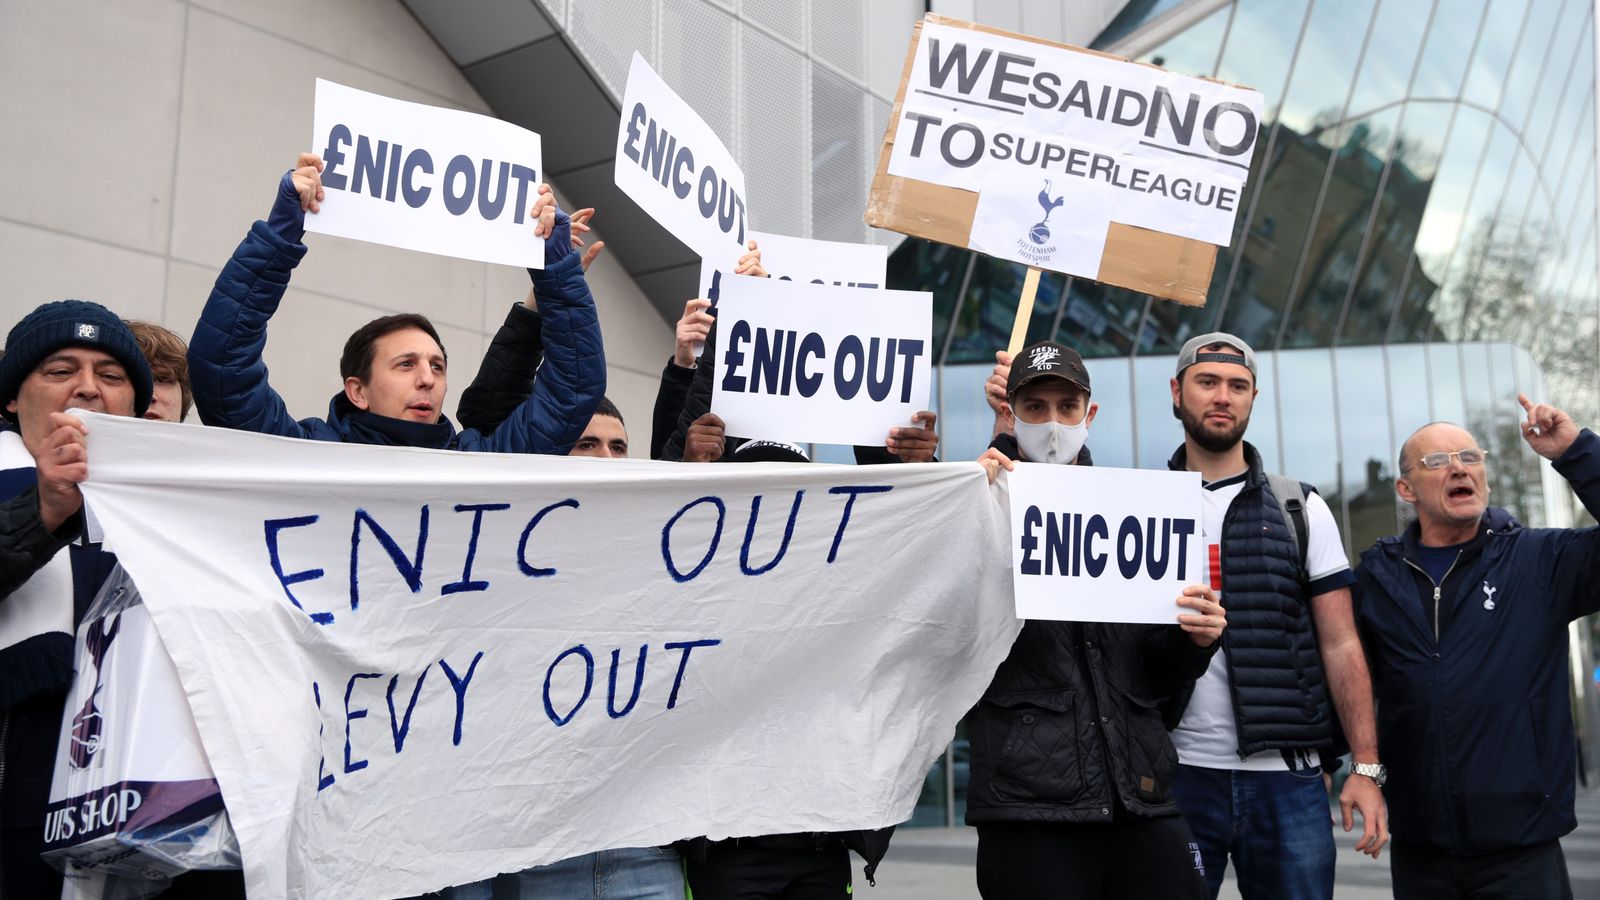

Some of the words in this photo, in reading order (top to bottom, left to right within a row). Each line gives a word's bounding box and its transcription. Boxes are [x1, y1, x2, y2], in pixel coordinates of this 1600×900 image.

[928, 37, 1036, 107] WE
[1027, 72, 1148, 128] SAID
[1144, 85, 1257, 156] NO
[321, 123, 434, 209] £NIC
[442, 154, 536, 225] OUT
[623, 102, 694, 200] £NIC
[698, 165, 747, 246] OUT
[905, 111, 985, 169] TO
[1016, 238, 1057, 254] TOTTENHAM
[1017, 249, 1051, 262] HOTSPUR
[721, 319, 826, 398] £NIC
[833, 334, 924, 404] OUT
[1037, 363, 1052, 371] KID
[264, 498, 580, 625] ENIC
[660, 484, 894, 583] OUT
[1020, 505, 1109, 578] £NIC
[1116, 515, 1196, 581] OUT
[312, 651, 484, 792] LEVY
[542, 639, 722, 728] OUT
[78, 789, 142, 835] SHOP
